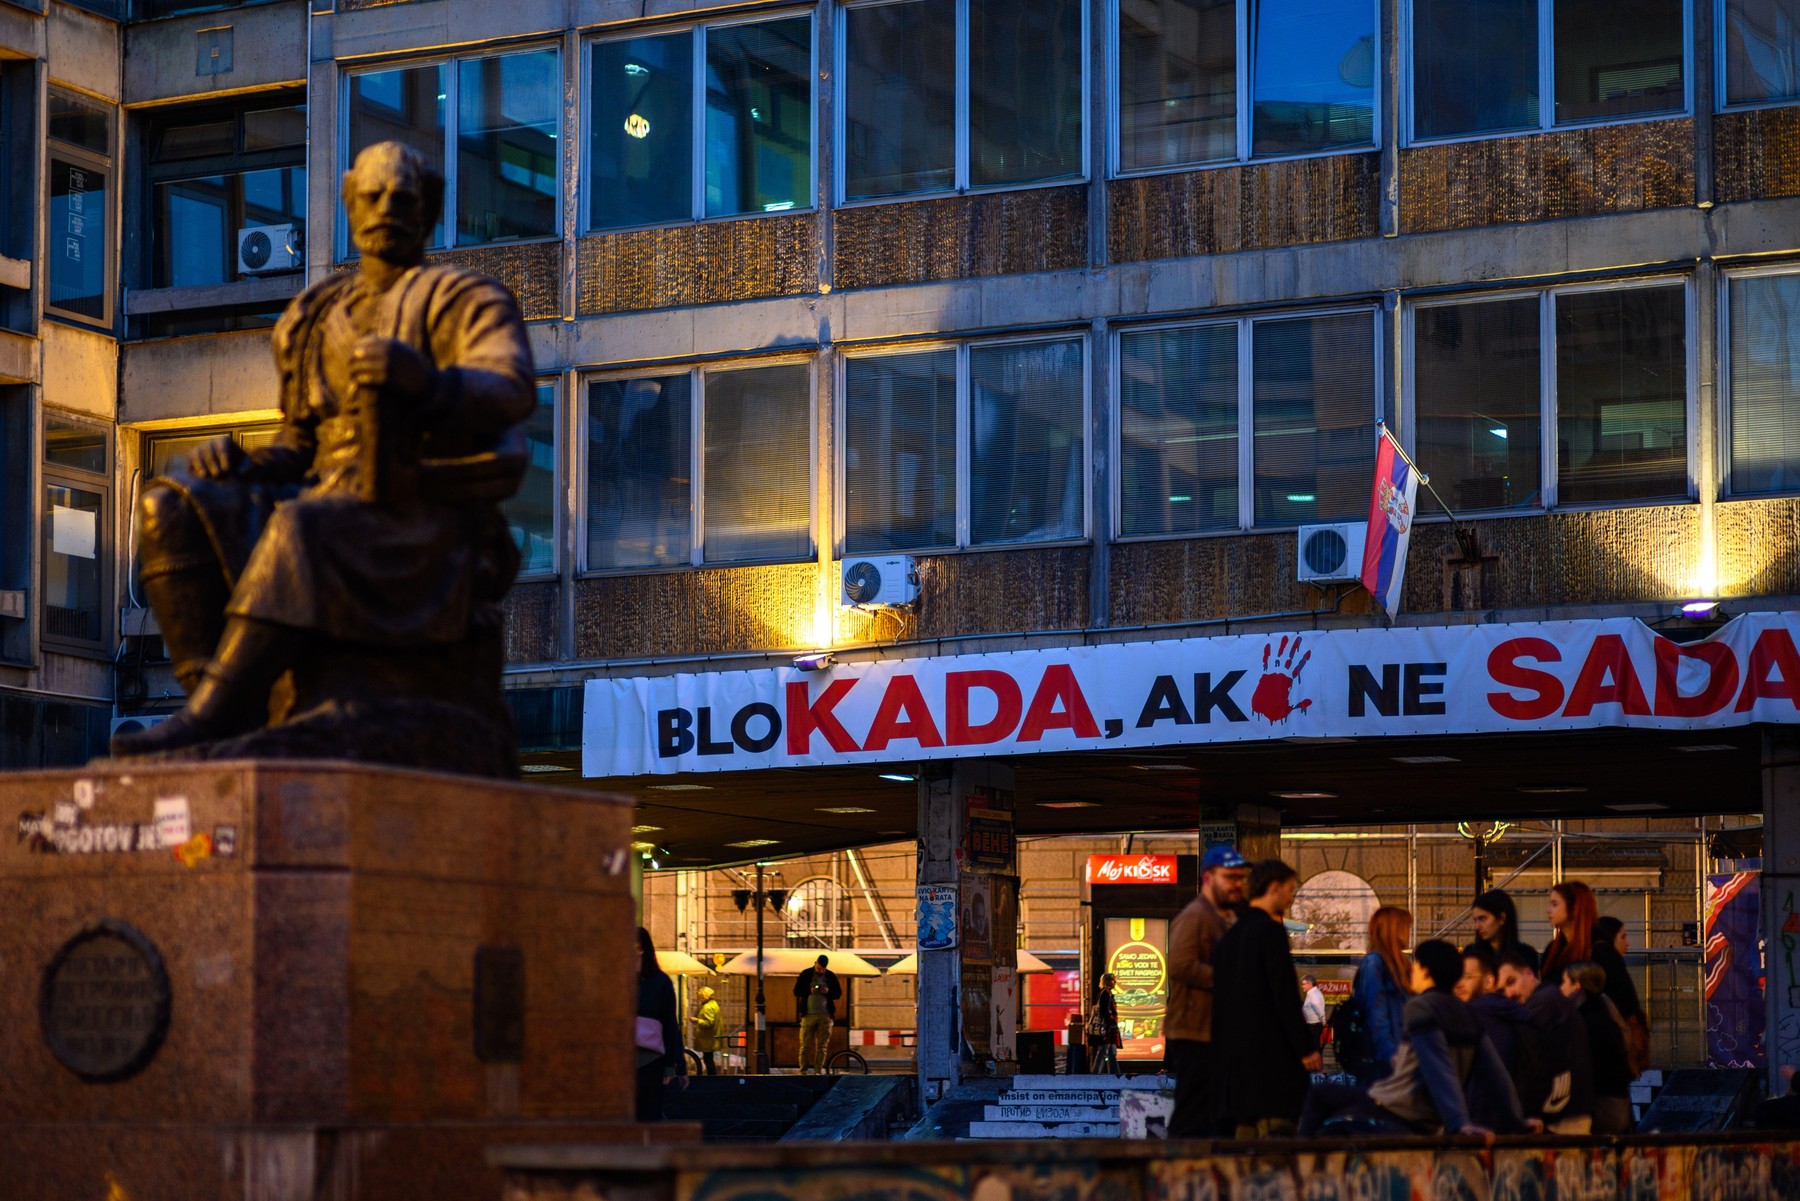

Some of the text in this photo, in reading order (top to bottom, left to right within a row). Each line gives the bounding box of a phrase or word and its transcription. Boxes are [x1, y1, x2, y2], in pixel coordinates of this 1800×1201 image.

[657, 664, 1124, 758] BLOKADA,
[1348, 662, 1447, 718] NE
[1486, 627, 1800, 721] SADA
[1097, 860, 1170, 880] Moj KIOSK
[1032, 1092, 1045, 1100] on
[1001, 1106, 1031, 1118] ПРОТИВ
